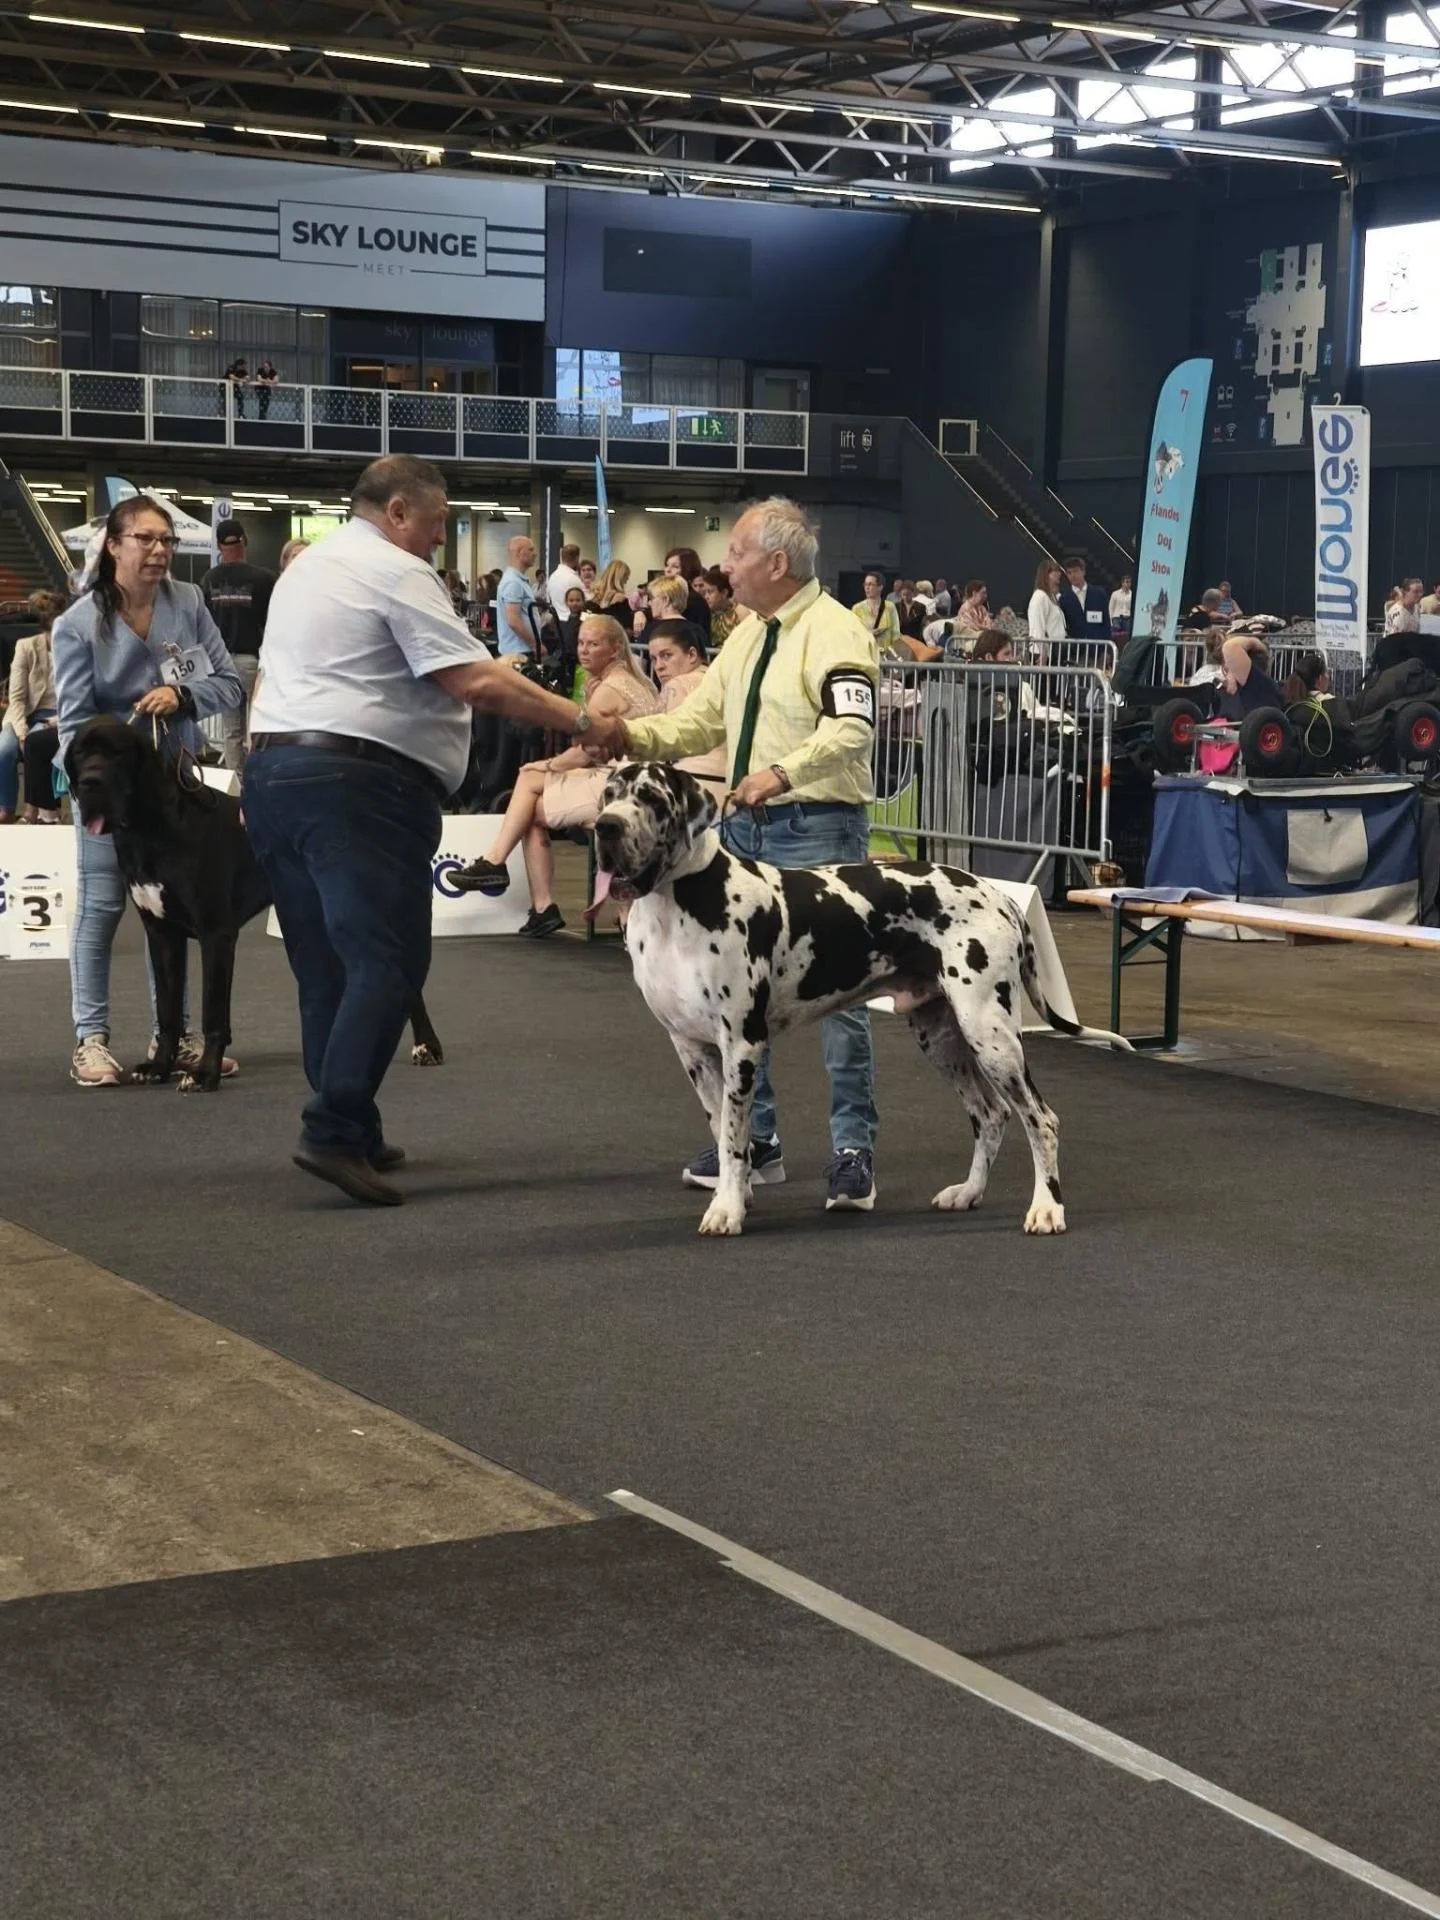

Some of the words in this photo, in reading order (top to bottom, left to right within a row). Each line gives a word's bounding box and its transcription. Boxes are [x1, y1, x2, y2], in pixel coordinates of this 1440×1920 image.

[292, 220, 349, 248] SKY
[358, 226, 477, 258] LOUNGE
[363, 262, 404, 276] MEET
[432, 323, 488, 348] lounge
[1179, 388, 1190, 414] 7
[840, 430, 856, 449] lift
[170, 659, 195, 681] 150
[22, 895, 52, 932] 3
